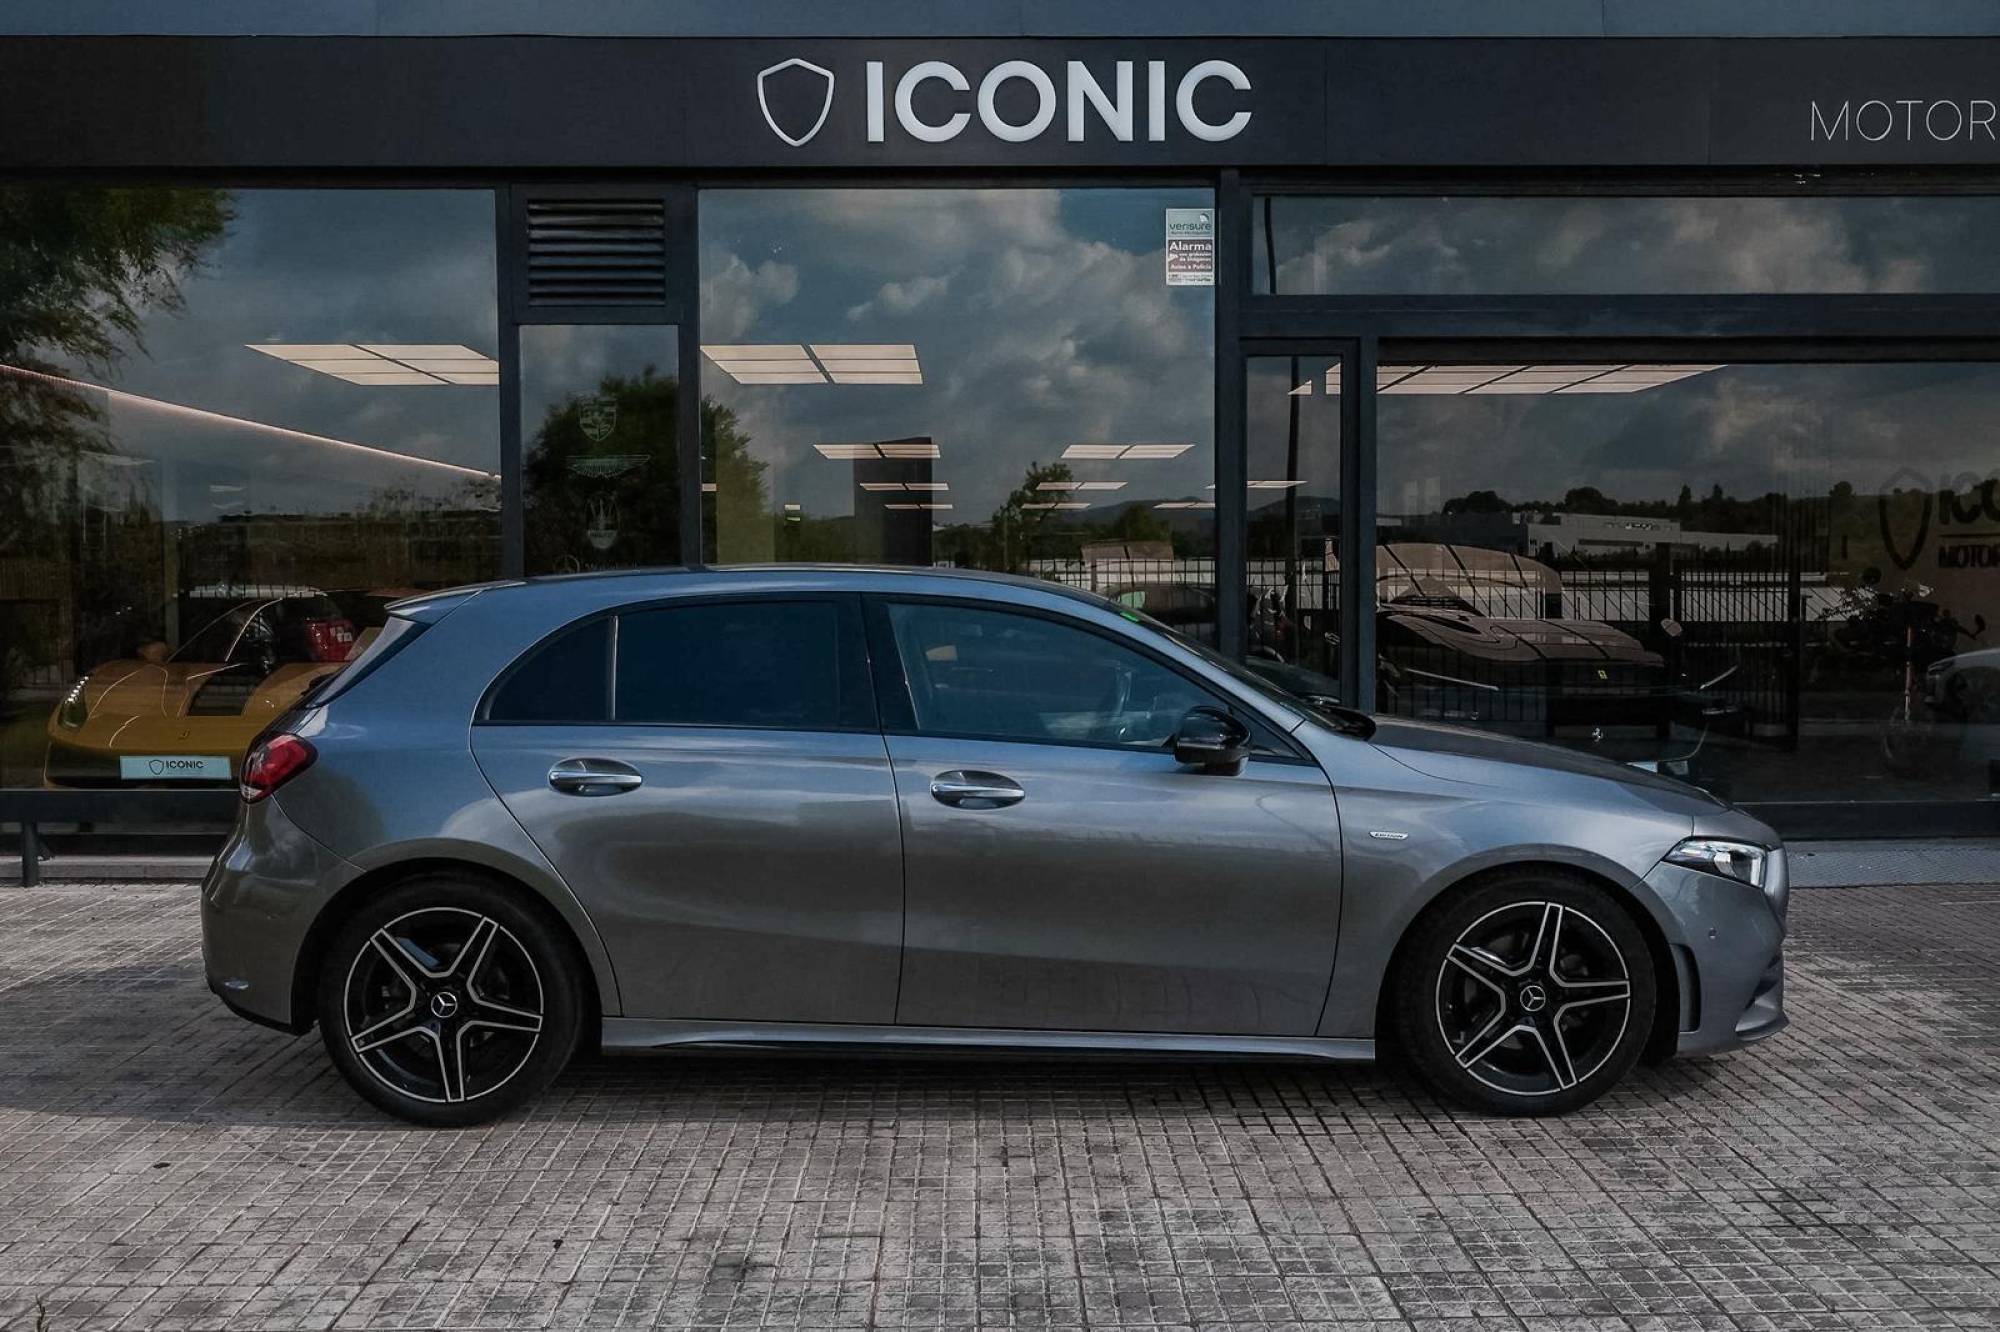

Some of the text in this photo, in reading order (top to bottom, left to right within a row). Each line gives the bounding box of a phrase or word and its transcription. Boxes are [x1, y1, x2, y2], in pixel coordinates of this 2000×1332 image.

[865, 59, 1253, 143] ICONIC
[1810, 100, 1998, 141] MOTOR
[1169, 222, 1212, 231] verisure
[1169, 241, 1212, 251] Alarma
[165, 760, 205, 769] ICONIC
